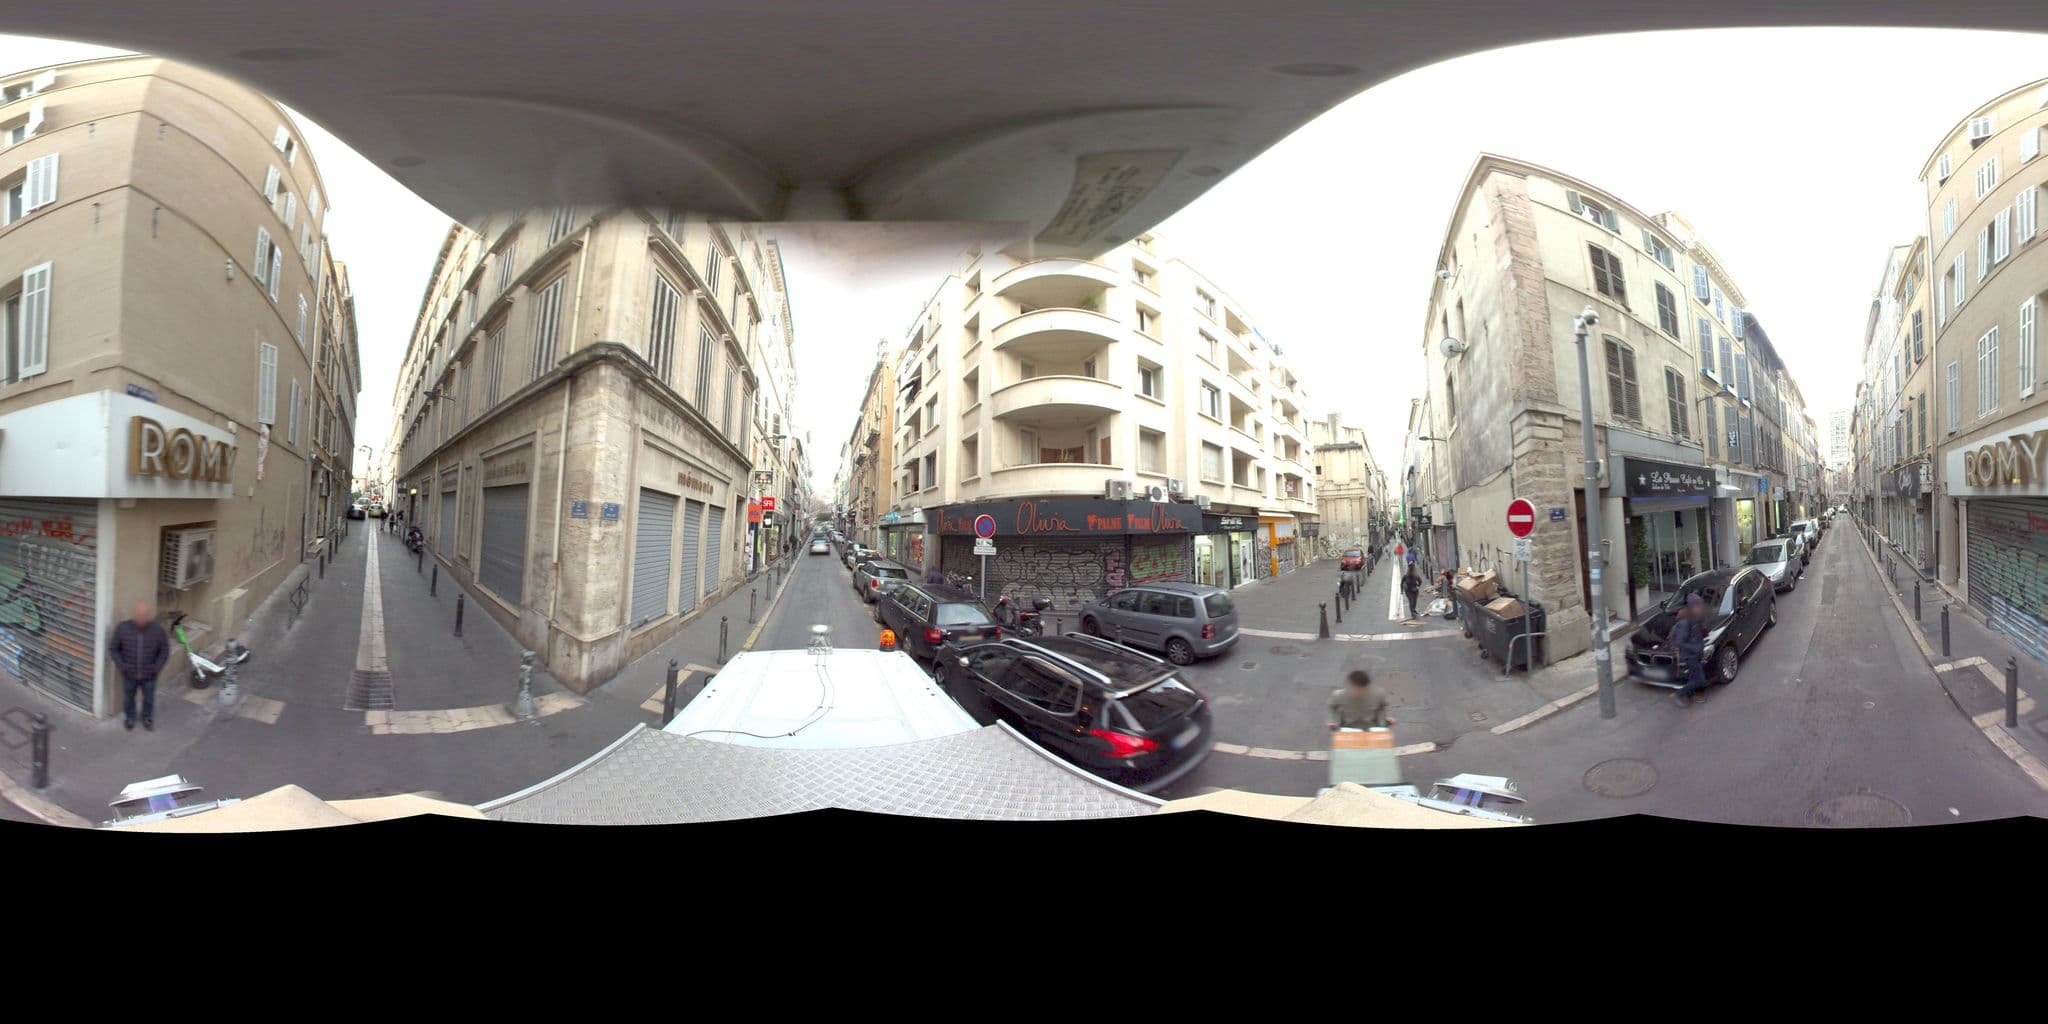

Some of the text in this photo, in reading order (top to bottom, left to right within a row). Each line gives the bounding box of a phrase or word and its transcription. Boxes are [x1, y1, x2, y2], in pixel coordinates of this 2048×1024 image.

[129, 416, 237, 483] ROMY
[1965, 430, 2047, 487] ROMY
[1017, 502, 1080, 535] Olivia
